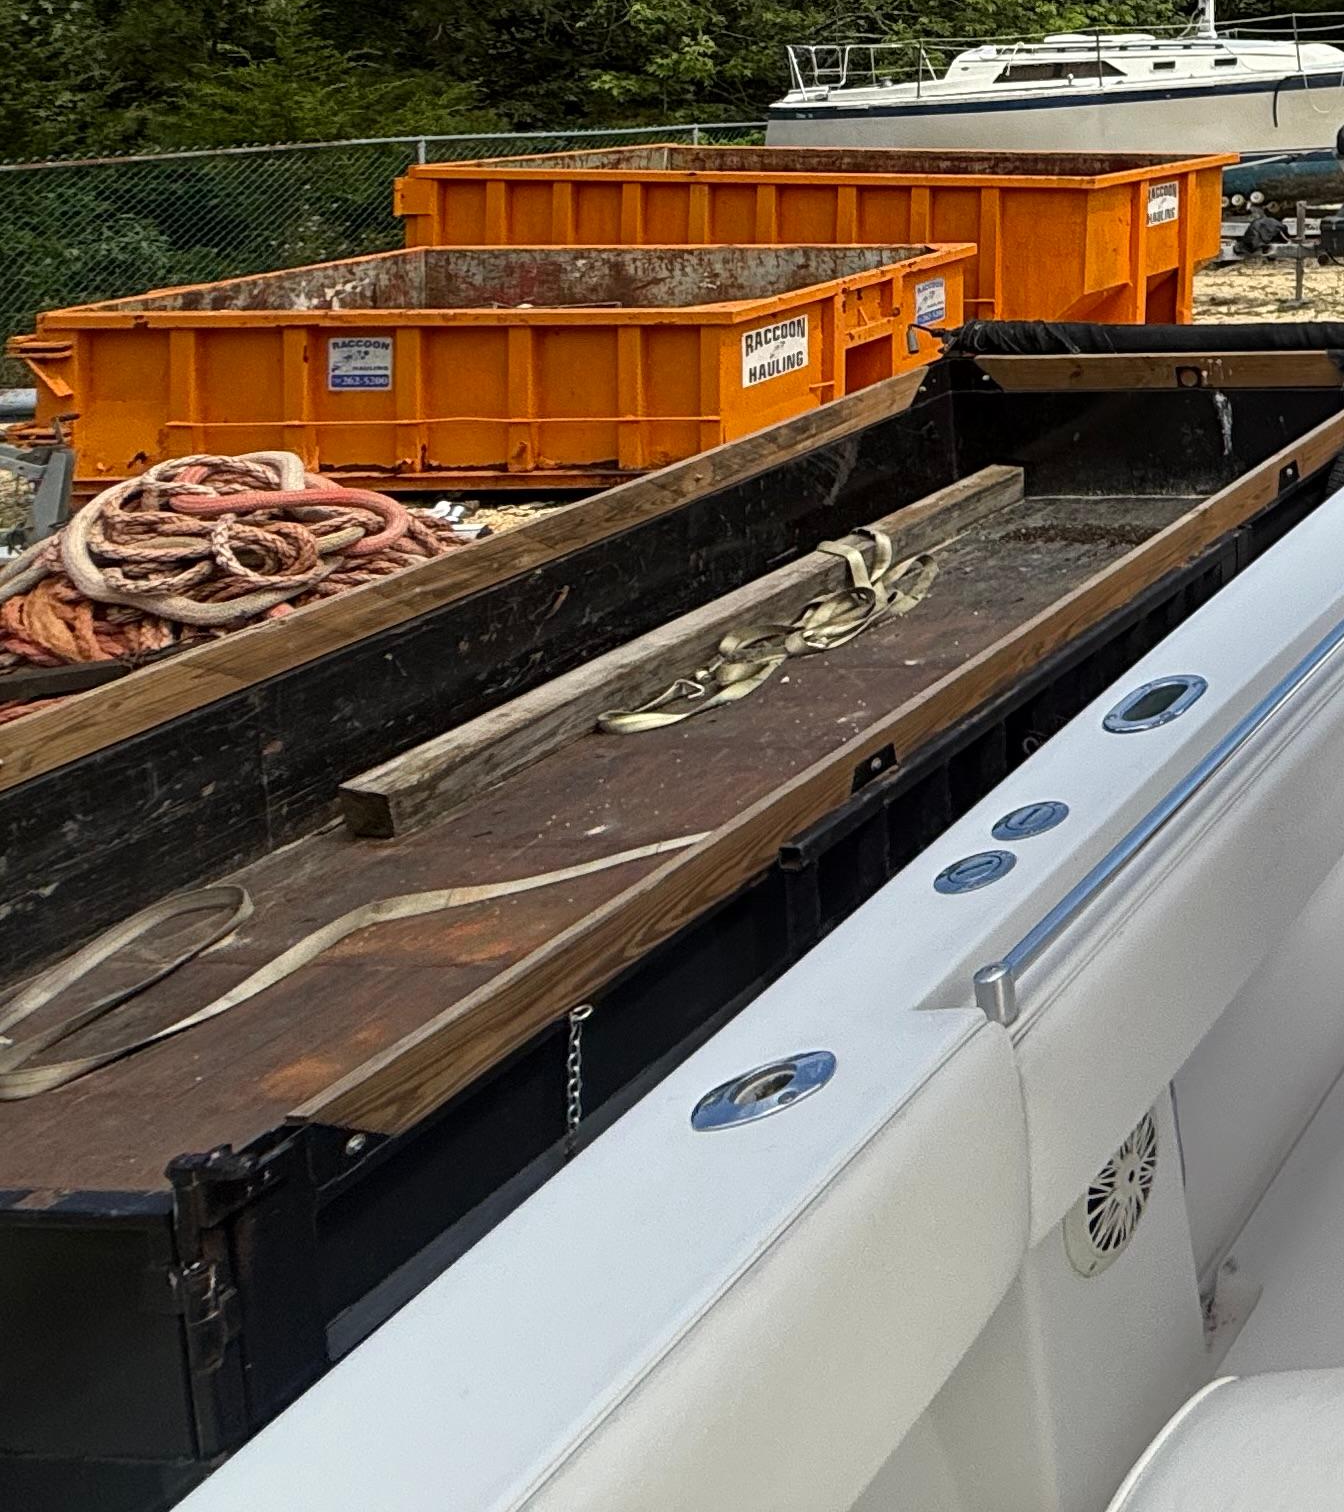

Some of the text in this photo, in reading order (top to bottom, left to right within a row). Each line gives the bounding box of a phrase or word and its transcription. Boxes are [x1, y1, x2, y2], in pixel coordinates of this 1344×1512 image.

[332, 339, 390, 350] RACCOON
[745, 317, 806, 357] RACCOON
[748, 350, 804, 383] HAULING
